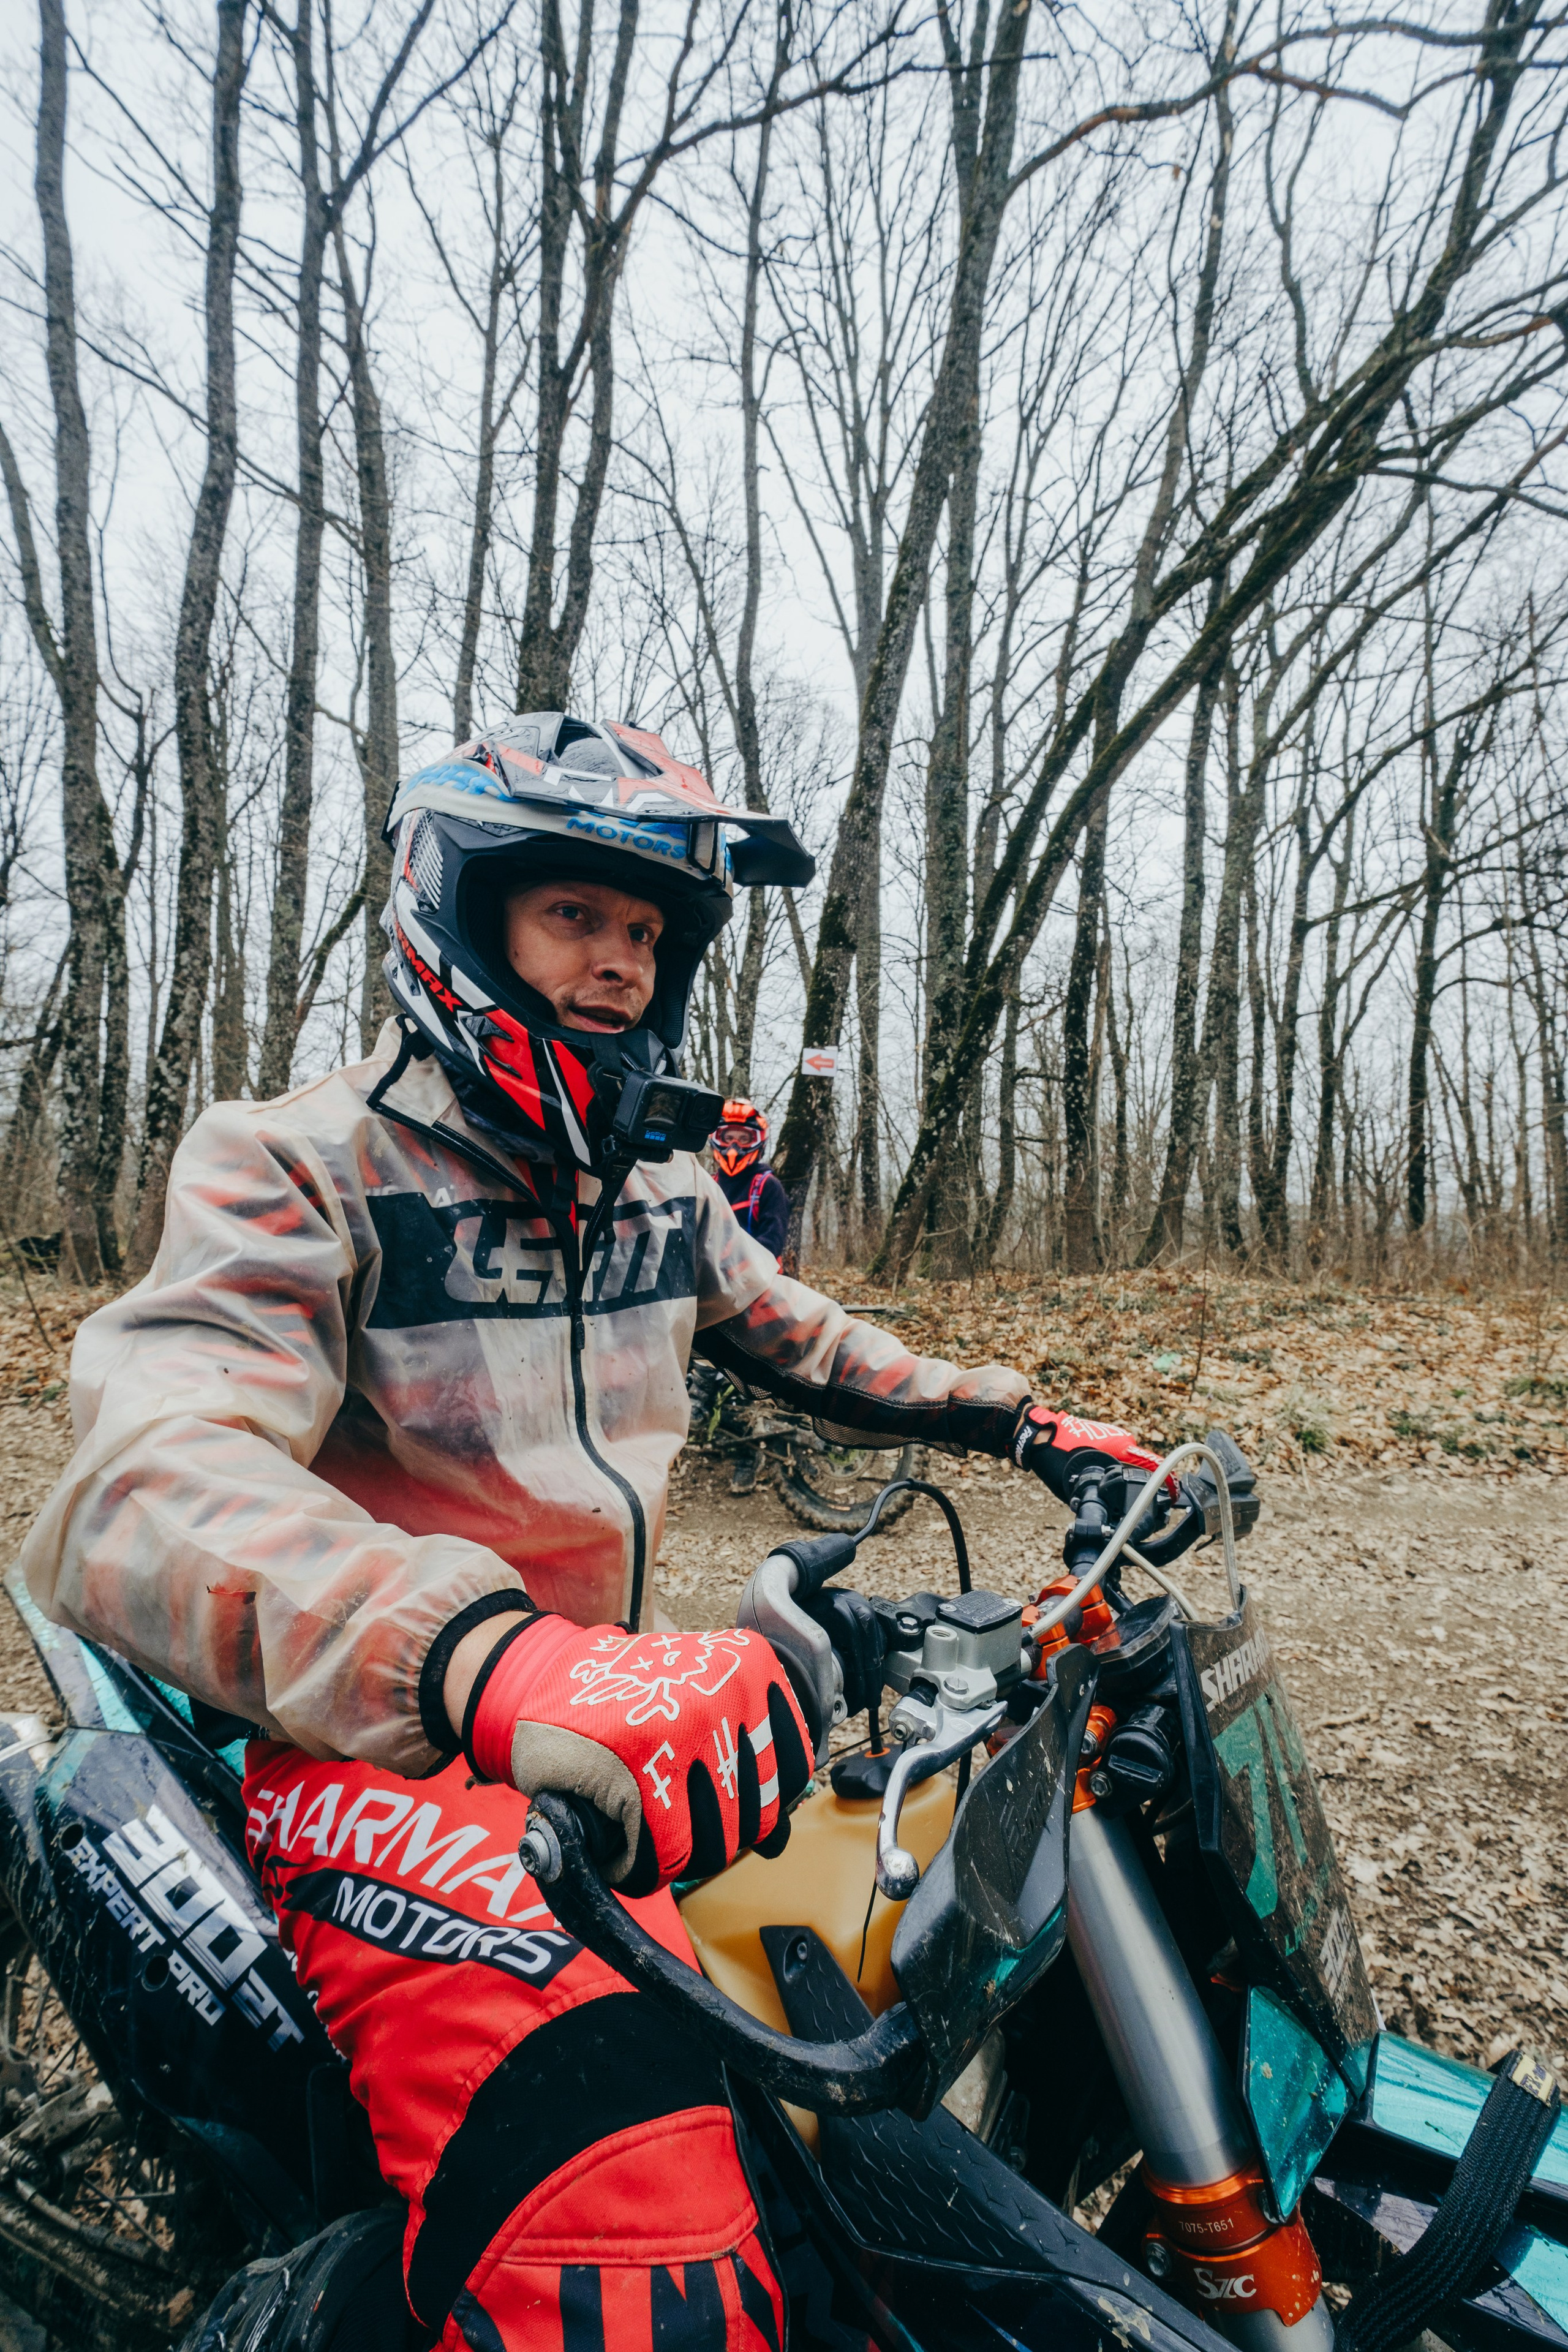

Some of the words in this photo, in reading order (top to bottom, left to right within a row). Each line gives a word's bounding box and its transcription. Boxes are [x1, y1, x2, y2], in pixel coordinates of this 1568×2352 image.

[566, 816, 687, 860] MOTORS
[247, 1780, 562, 1928] SHARMA
[67, 1836, 167, 1953] EXPERT
[167, 1949, 227, 2026] PRO
[332, 1877, 570, 1974] MOTORS
[1178, 2217, 1234, 2234] 7075-T651
